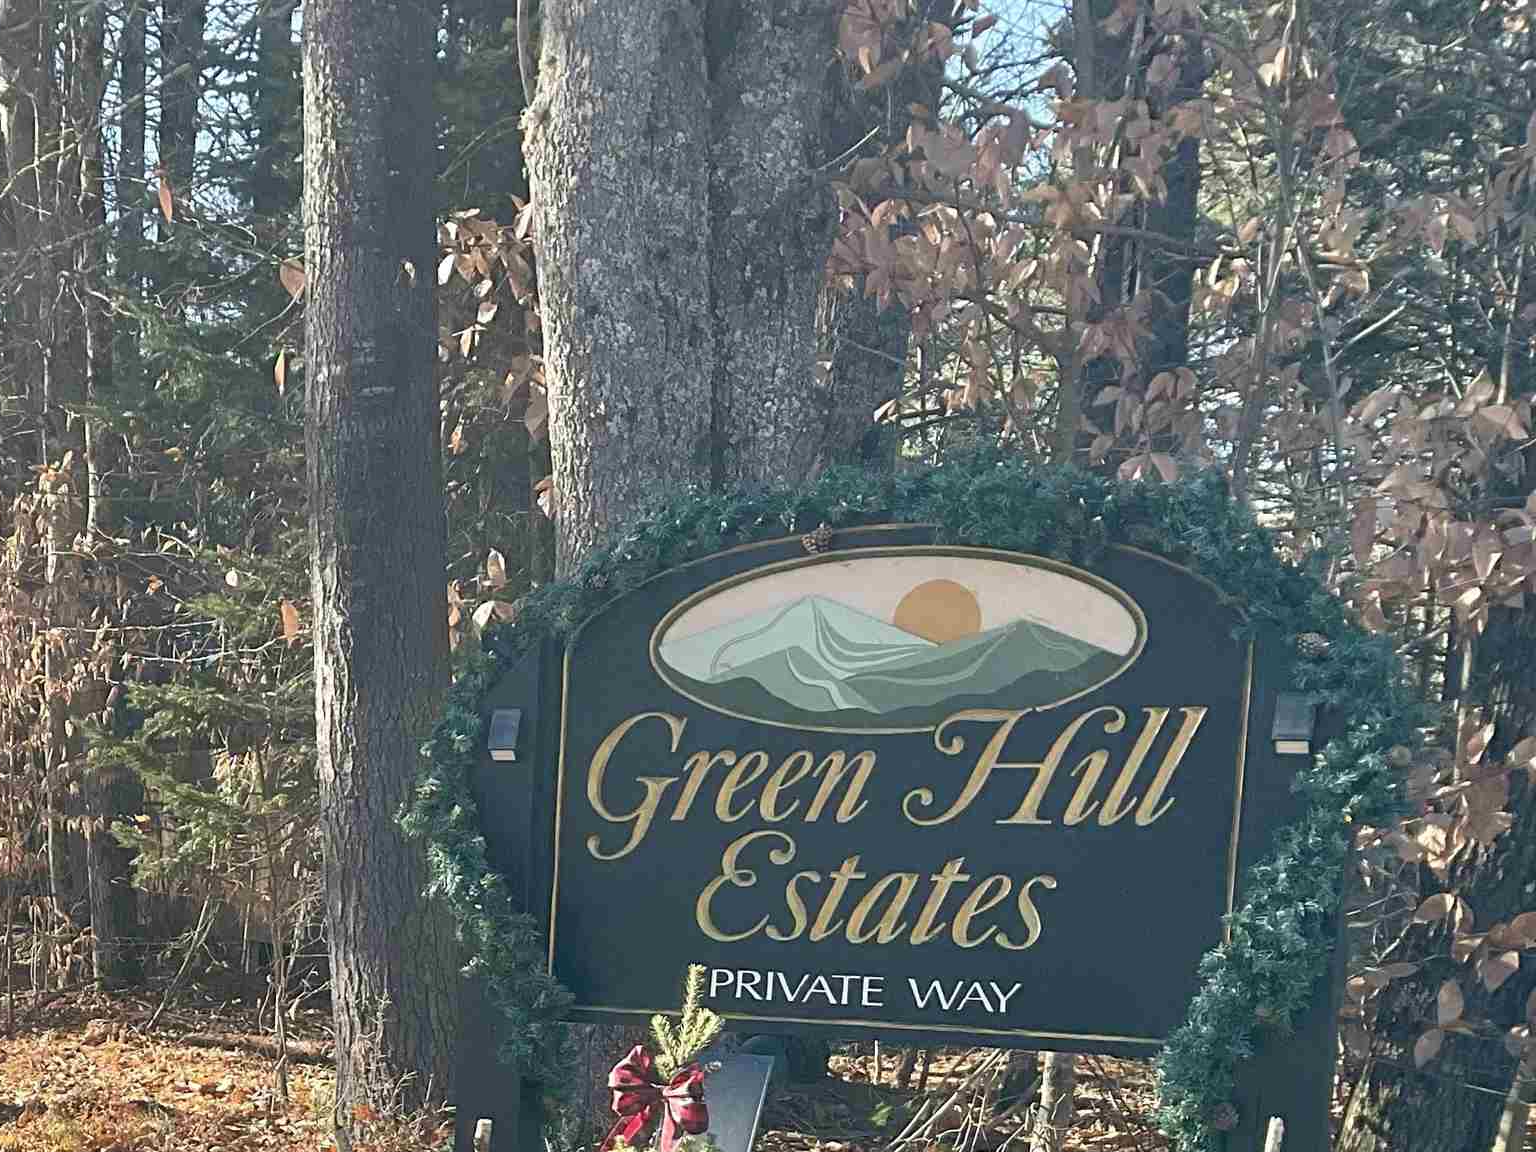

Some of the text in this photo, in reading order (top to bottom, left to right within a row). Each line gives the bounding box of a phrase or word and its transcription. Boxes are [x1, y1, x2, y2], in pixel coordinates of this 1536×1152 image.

[586, 705, 1208, 860] Green Hill
[695, 830, 1057, 950] Estates
[709, 968, 1022, 1013] PRIVATE WAY
